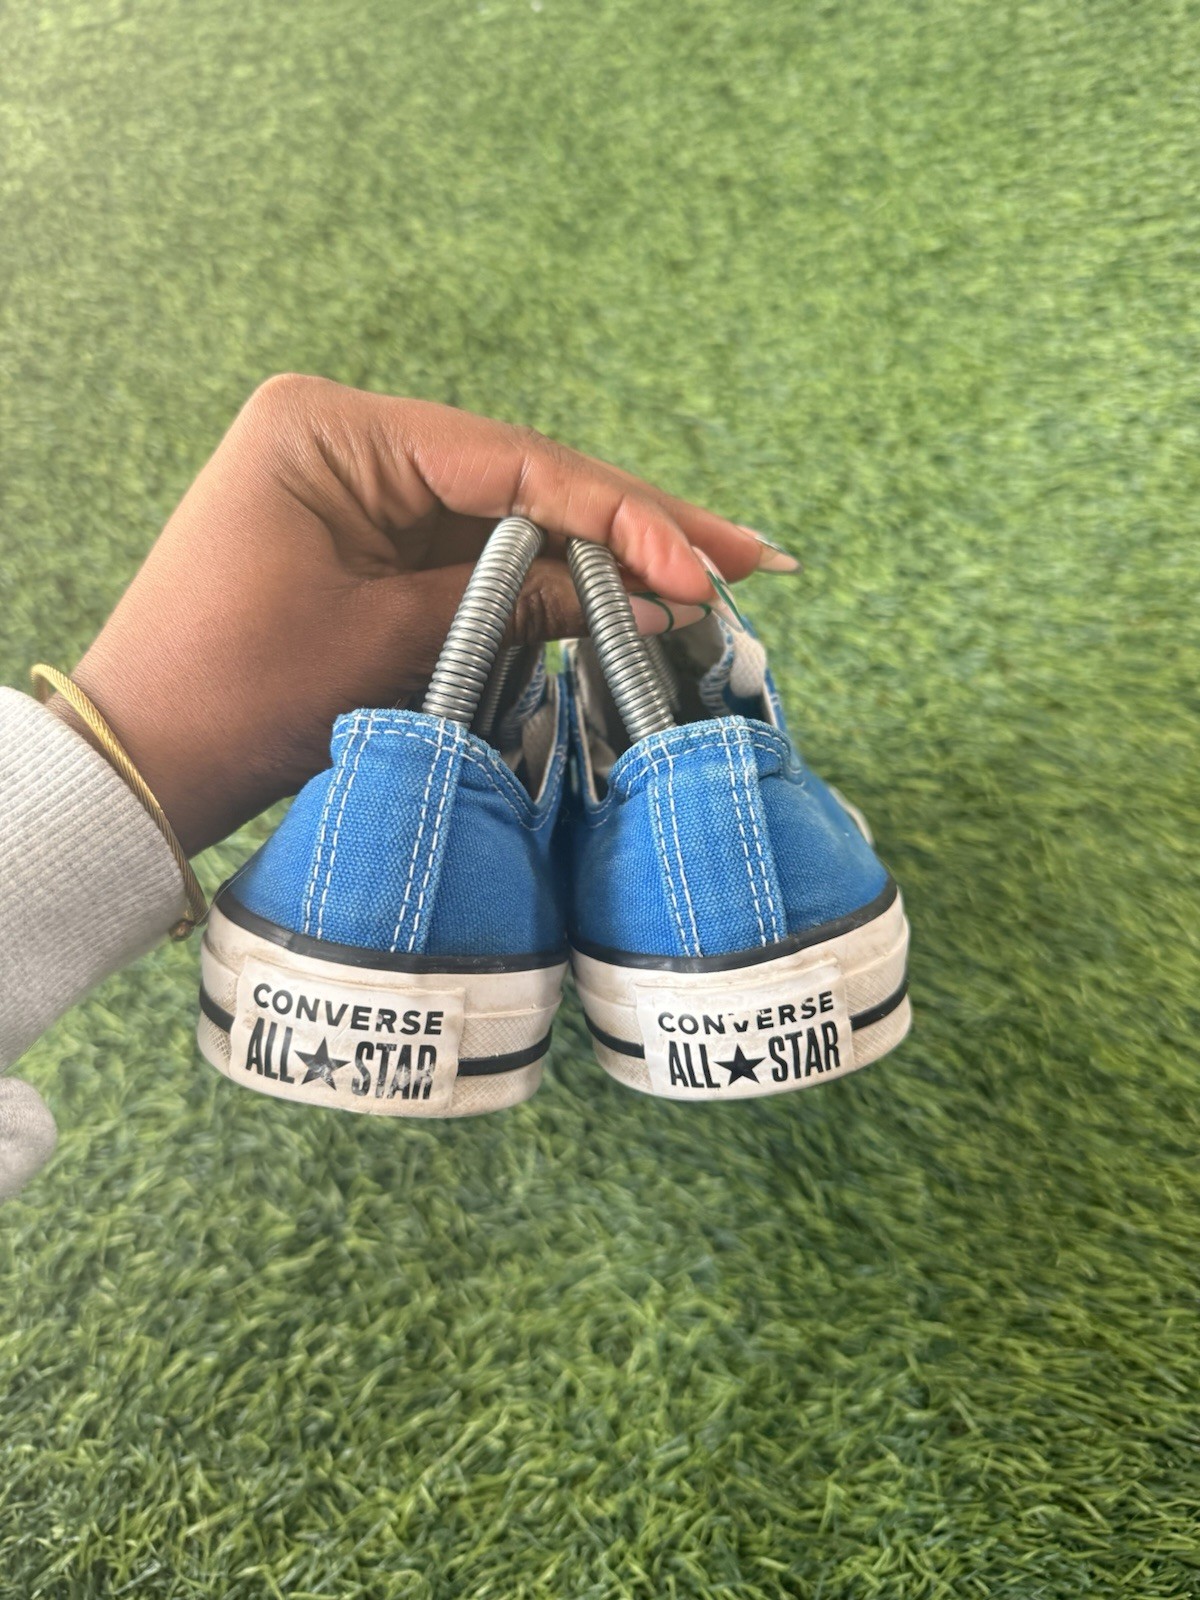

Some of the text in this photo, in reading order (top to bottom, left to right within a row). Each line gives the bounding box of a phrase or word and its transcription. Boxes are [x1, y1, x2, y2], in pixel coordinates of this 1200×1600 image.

[253, 983, 444, 1035] CONVERSE
[245, 1017, 437, 1100] ALL STAR
[668, 1020, 840, 1088] ALL STAR
